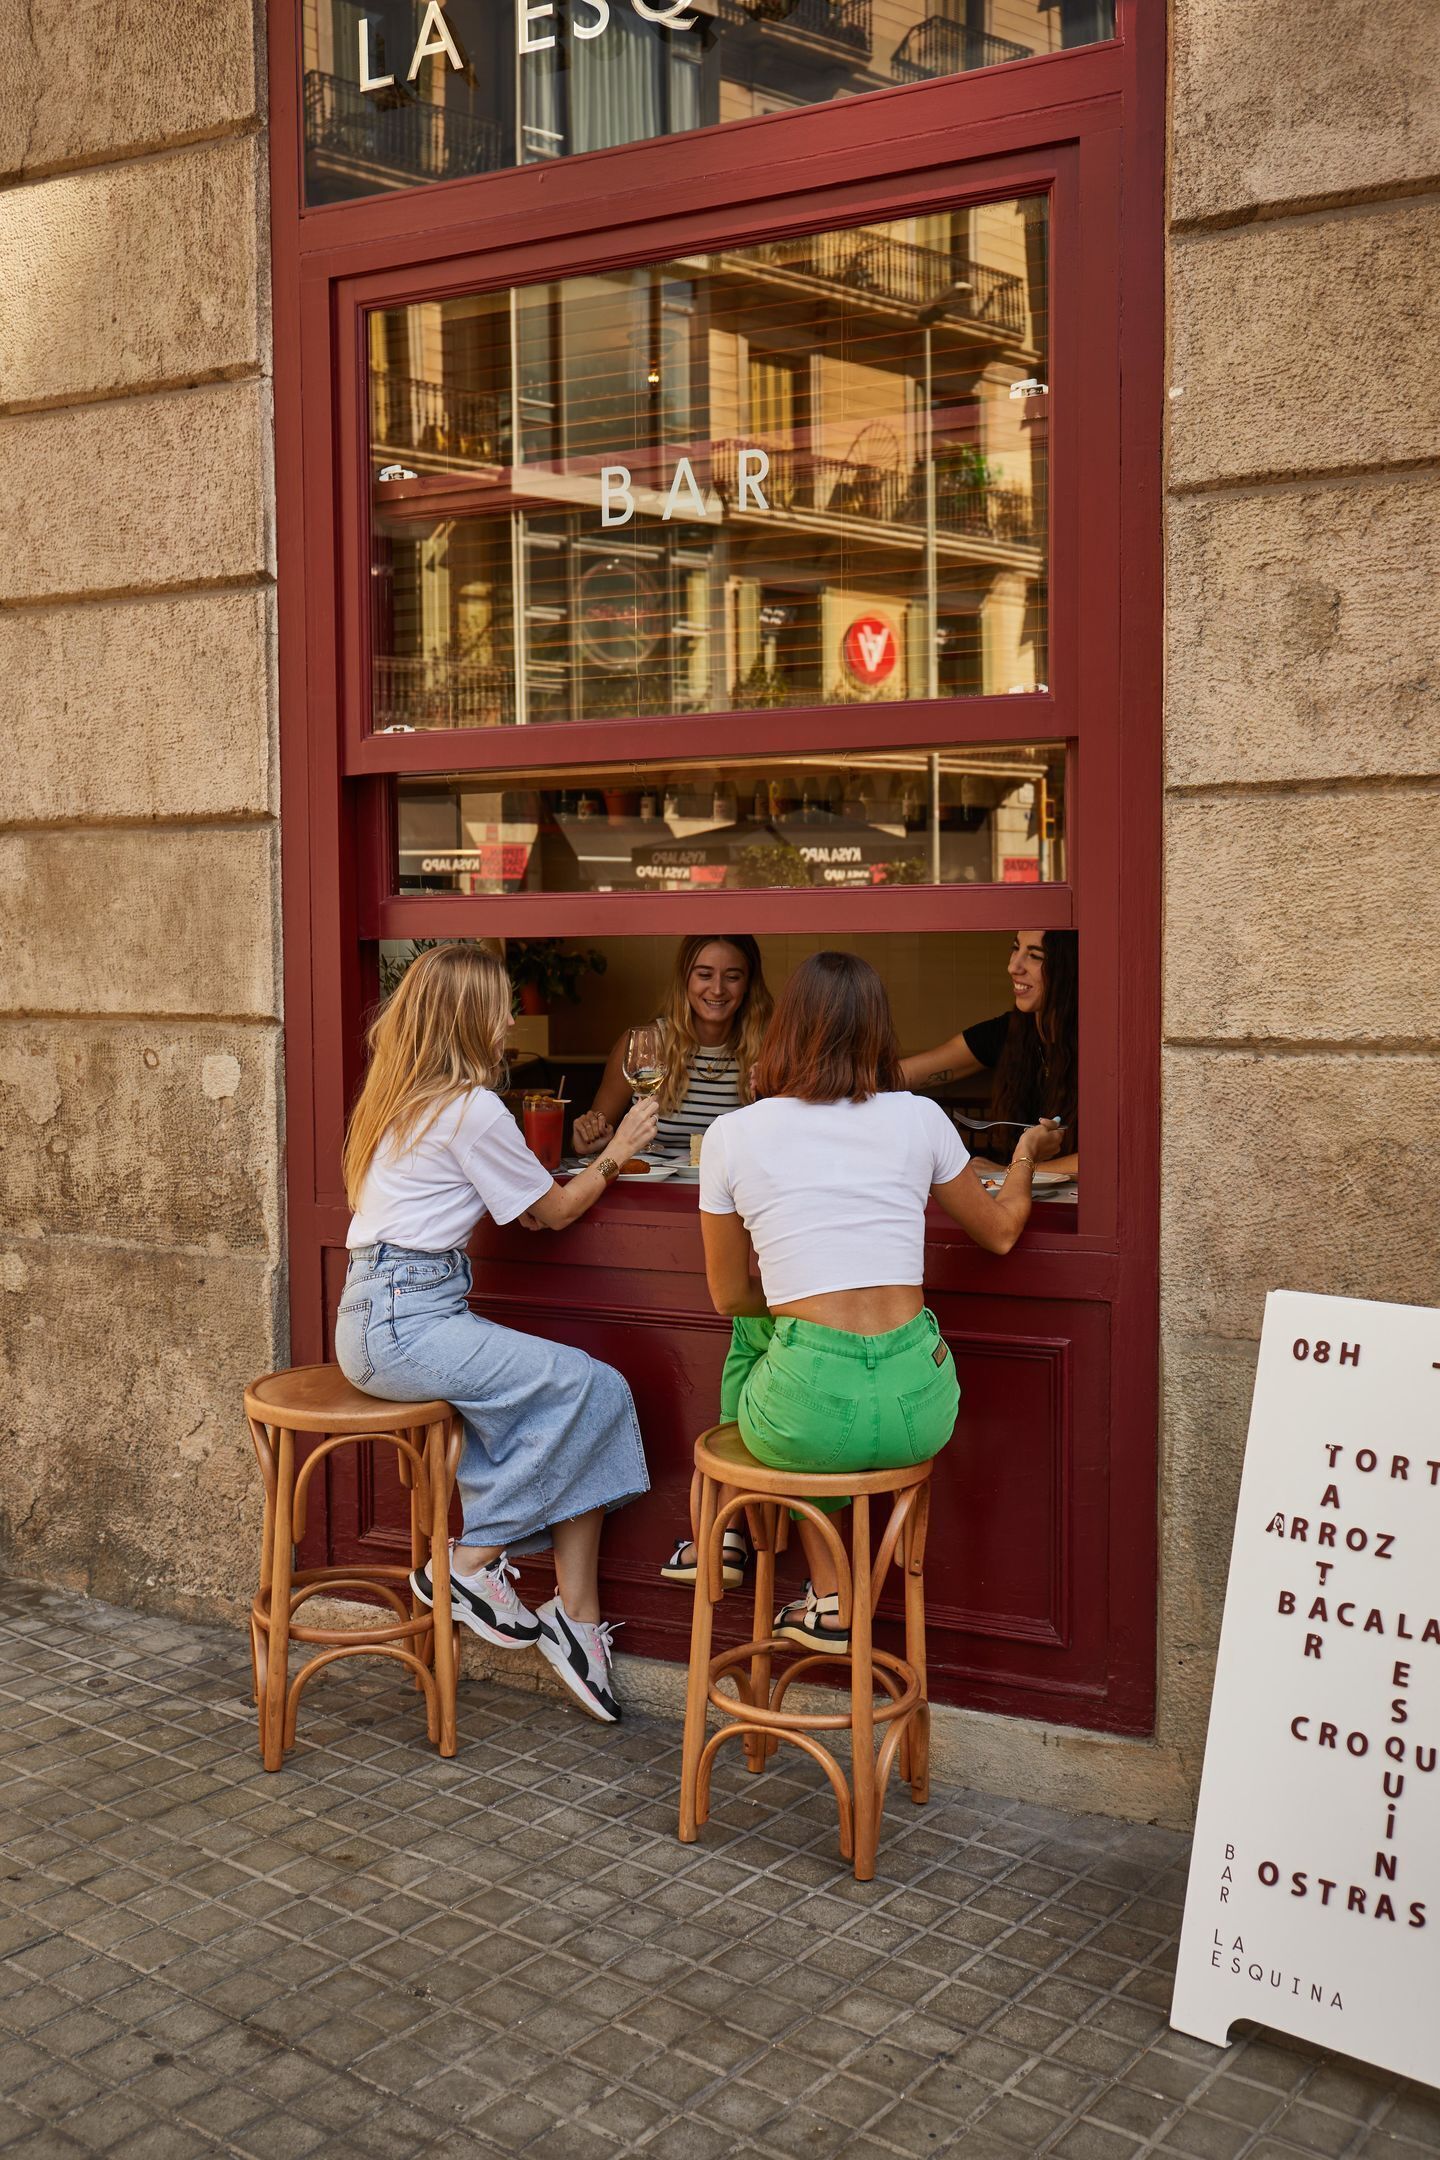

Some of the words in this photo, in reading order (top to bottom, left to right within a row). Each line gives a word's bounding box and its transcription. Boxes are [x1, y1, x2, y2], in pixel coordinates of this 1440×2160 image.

[358, 0, 464, 92] LA
[601, 449, 770, 527] BAR
[1293, 1338, 1361, 1367] 08H
[1265, 1512, 1395, 1559] ARROZ
[1278, 1591, 1440, 1645] BACALA
[1291, 1716, 1438, 1774] CROQU
[1258, 1861, 1426, 1929] OSTRAS
[1214, 1929, 1244, 1954] LA
[1211, 1950, 1343, 2010] ESQUINA
